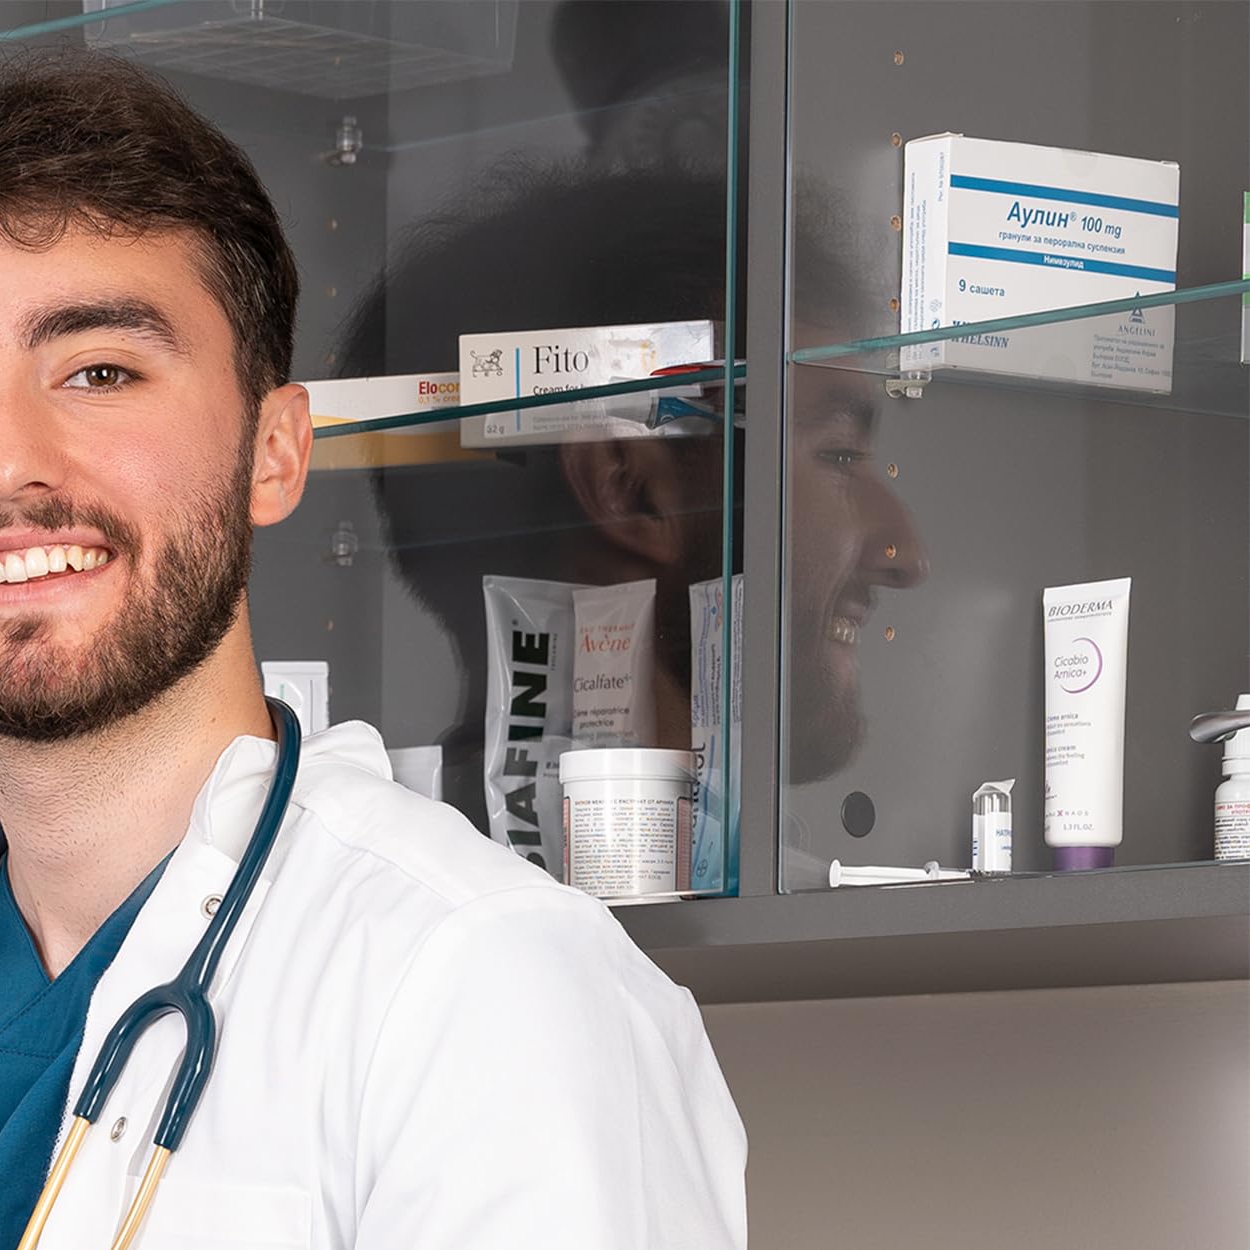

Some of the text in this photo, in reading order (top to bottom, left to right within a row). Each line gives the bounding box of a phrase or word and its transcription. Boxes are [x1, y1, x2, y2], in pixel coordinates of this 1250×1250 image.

[1081, 216, 1103, 233] 100
[1104, 224, 1122, 239] mg
[998, 231, 1126, 255] гранули за перорална суспензия
[958, 278, 1005, 297] 9 сашета
[532, 344, 589, 374] Fito
[1047, 599, 1114, 618] BIODERMA
[581, 633, 631, 653] Avène
[1053, 654, 1090, 668] Cicabio
